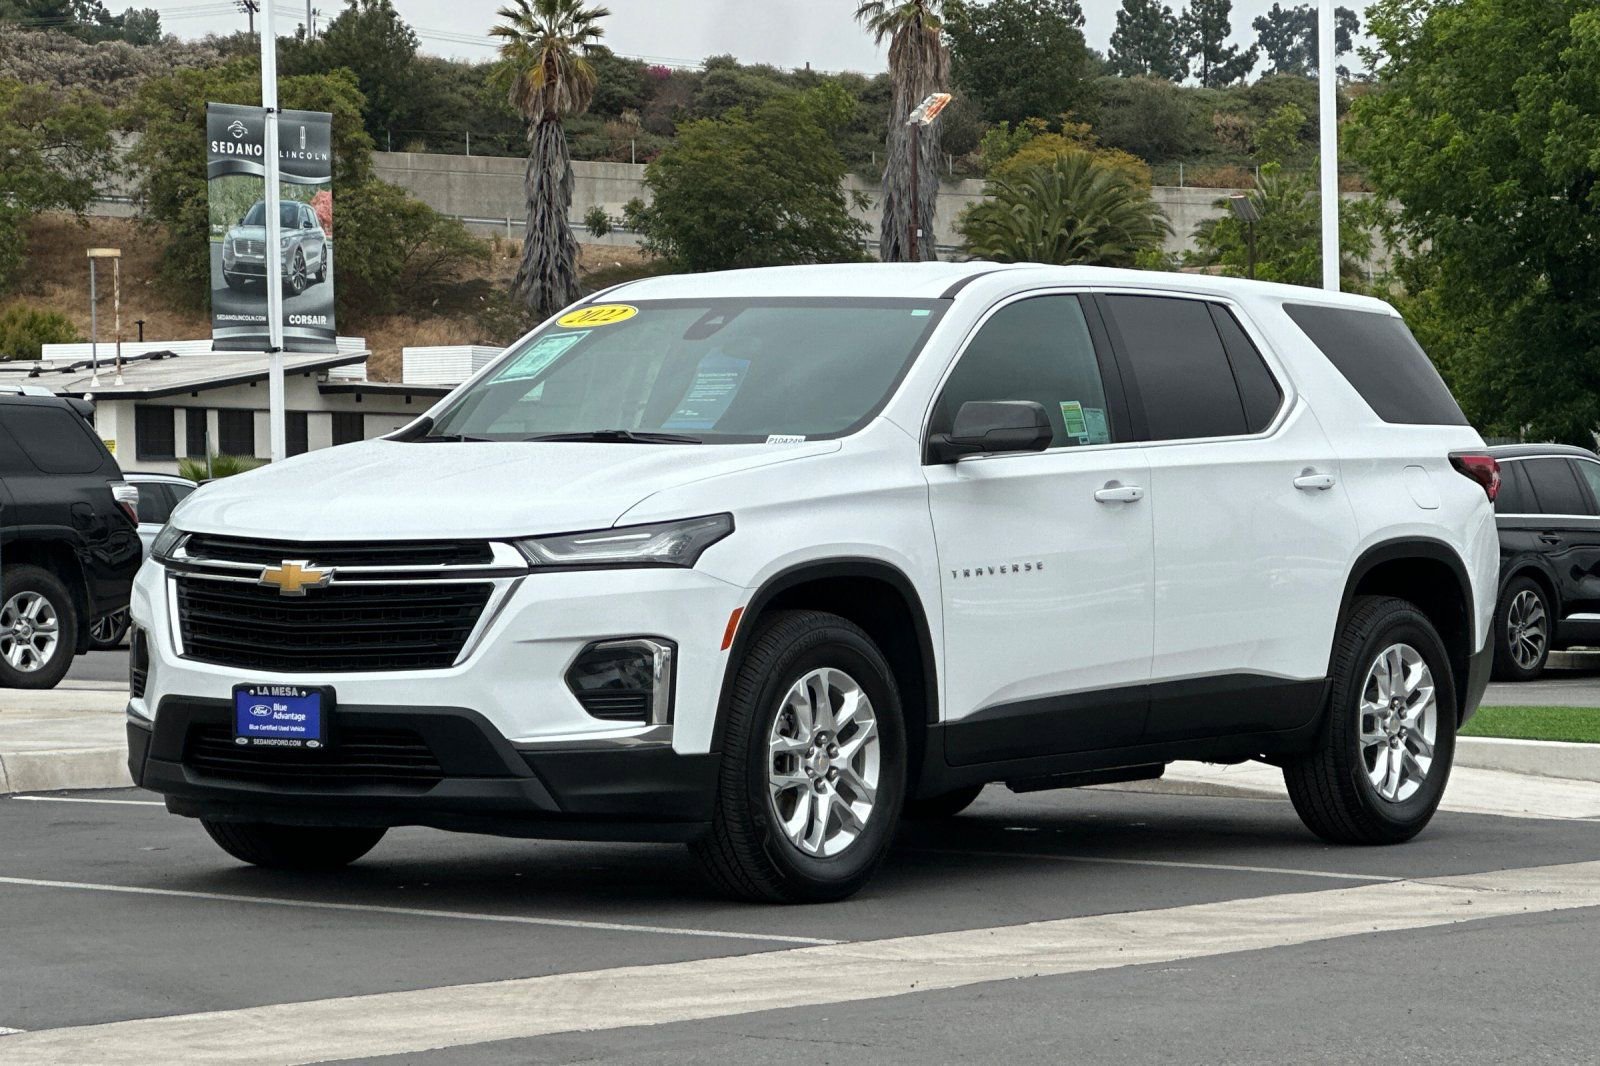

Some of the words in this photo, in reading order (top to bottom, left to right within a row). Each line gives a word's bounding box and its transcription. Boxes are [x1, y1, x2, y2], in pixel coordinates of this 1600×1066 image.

[211, 140, 263, 156] SEDANO
[279, 150, 327, 160] LINCOLN
[216, 314, 267, 322] SEDANOLINCOLN.COM
[288, 314, 327, 325] CORSAIR
[564, 308, 629, 324] 2022
[951, 561, 1043, 579] TRAVERSE
[257, 686, 269, 696] LA
[271, 687, 298, 697] MESA
[273, 703, 288, 711] Blue
[273, 712, 306, 721] Advantage
[253, 738, 302, 747] SEDANOFORD.COM
